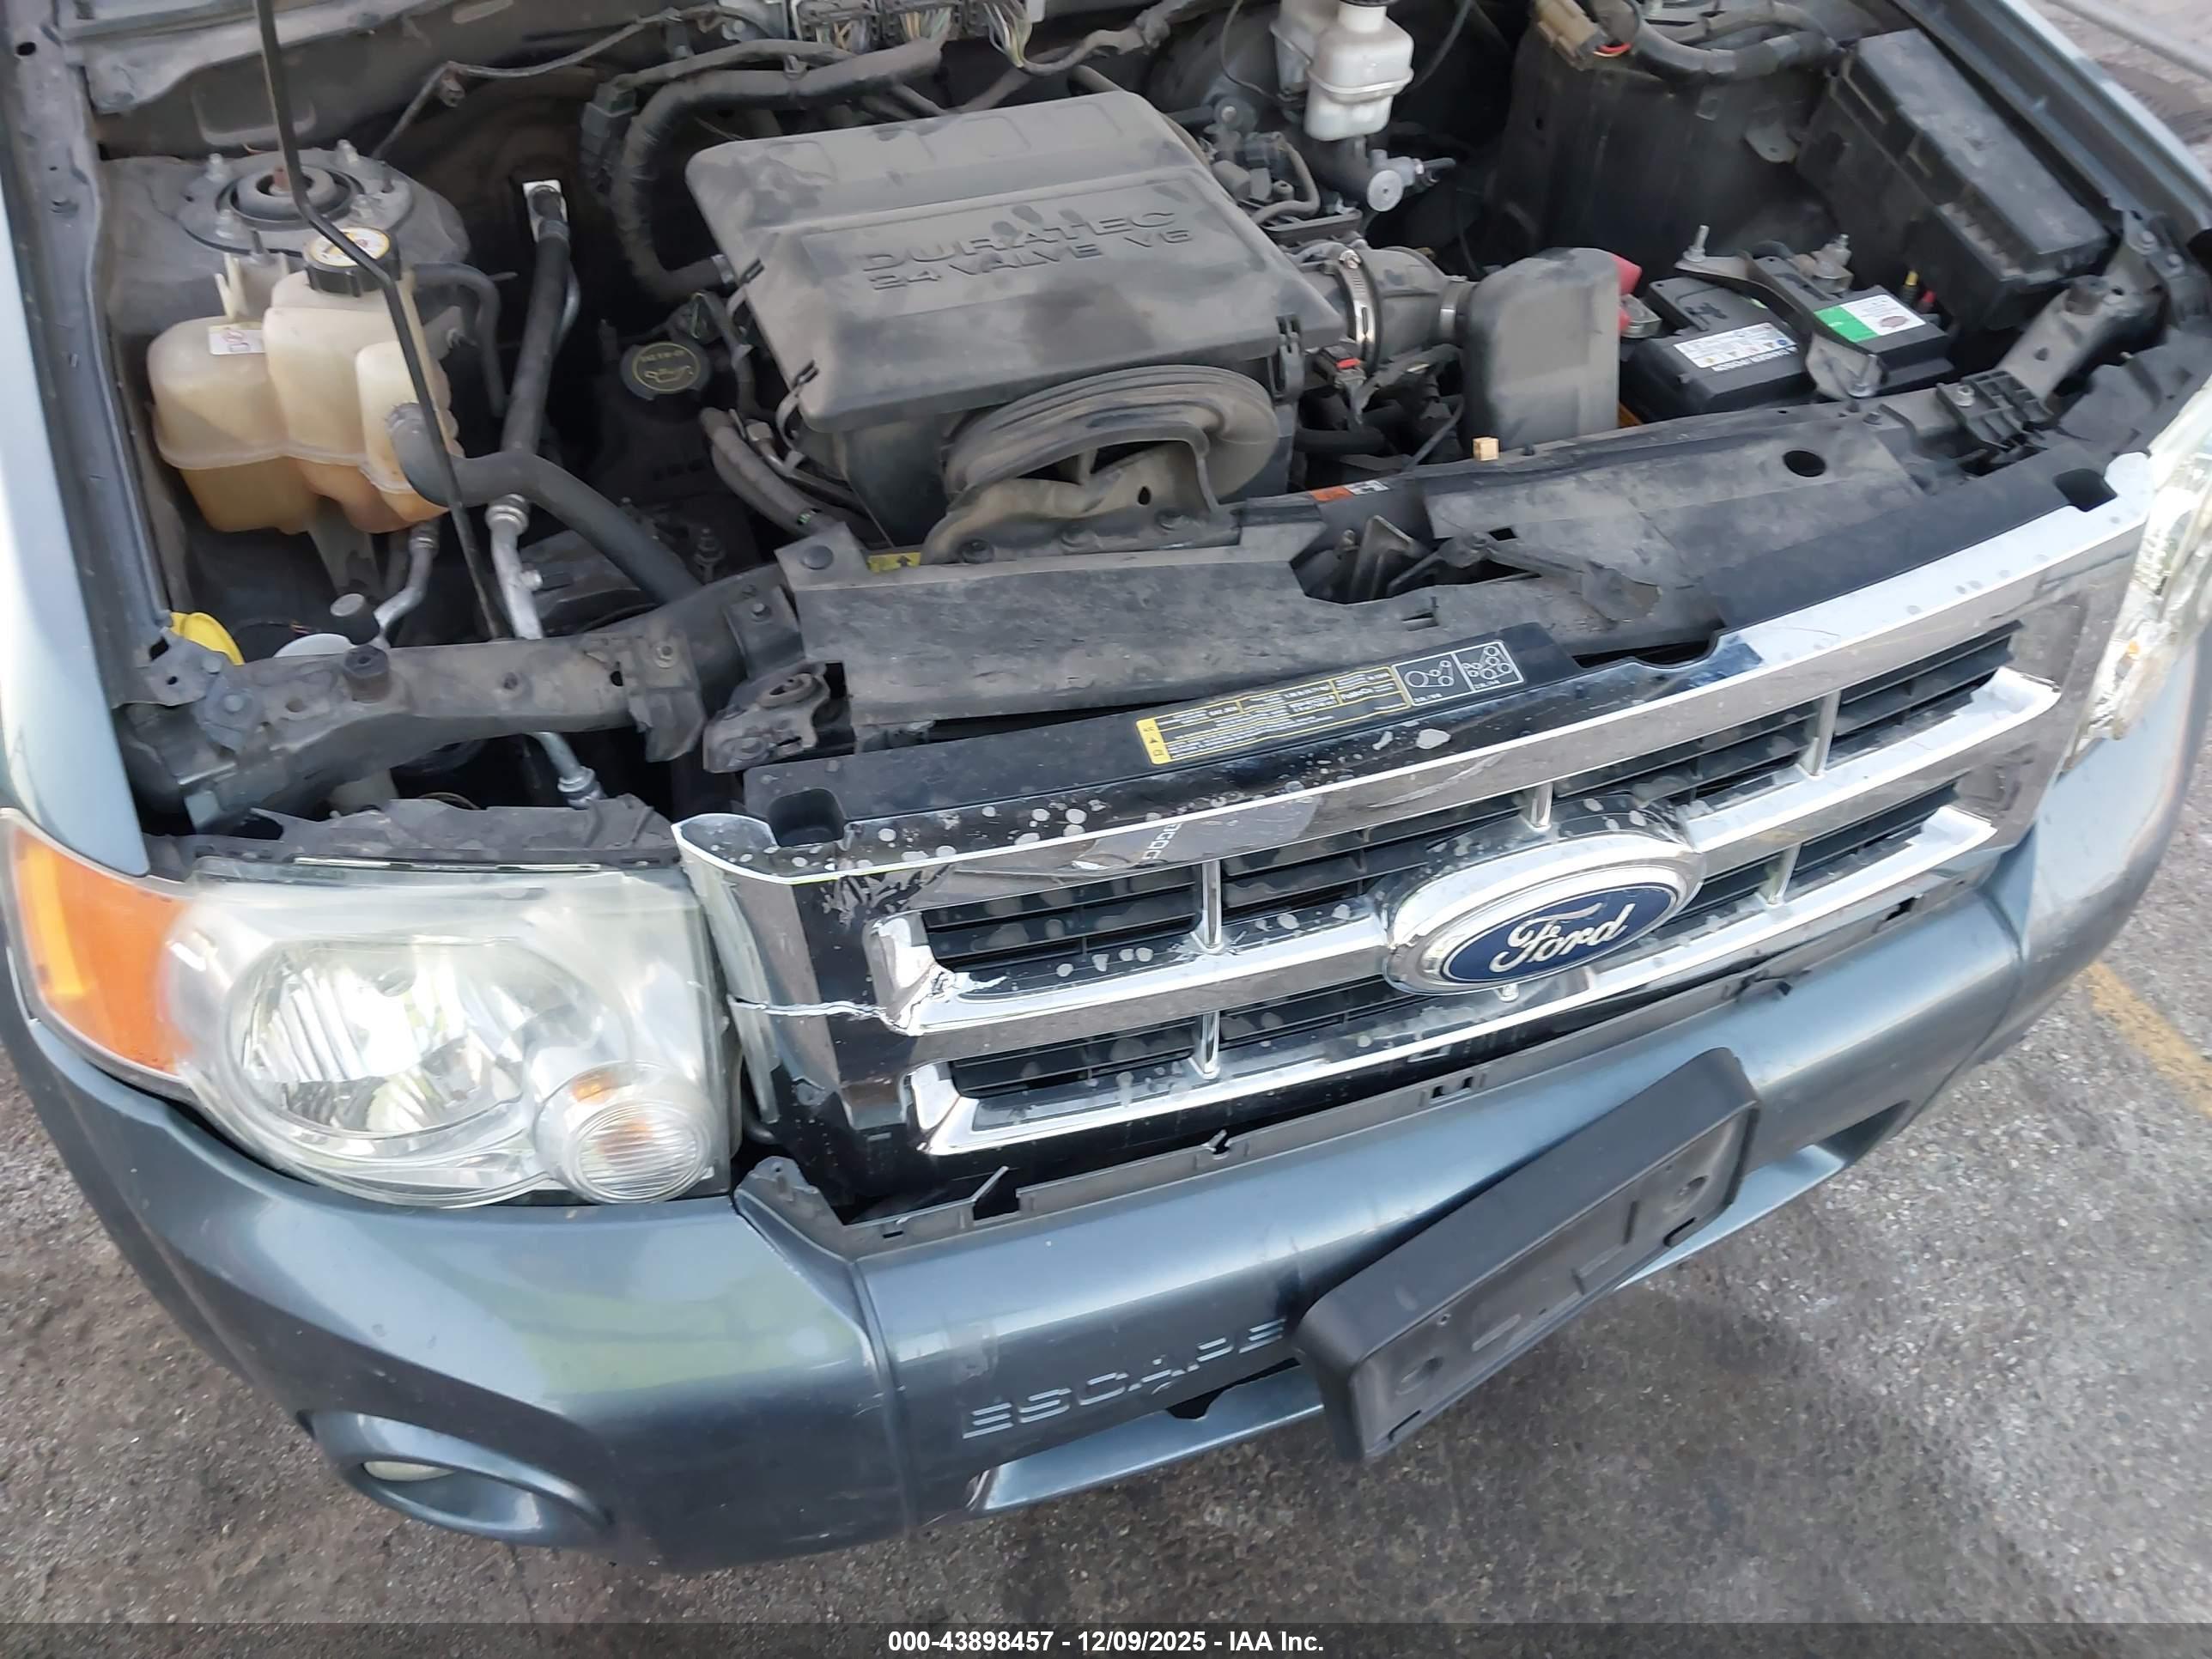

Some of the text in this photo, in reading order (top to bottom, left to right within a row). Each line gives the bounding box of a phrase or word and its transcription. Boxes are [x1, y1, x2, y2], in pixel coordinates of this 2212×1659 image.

[860, 211, 1176, 271] DURATEC
[868, 229, 1194, 290] 24 VALVE V6
[1488, 902, 1636, 973] Ford
[962, 1317, 1287, 1440] ESCAPE
